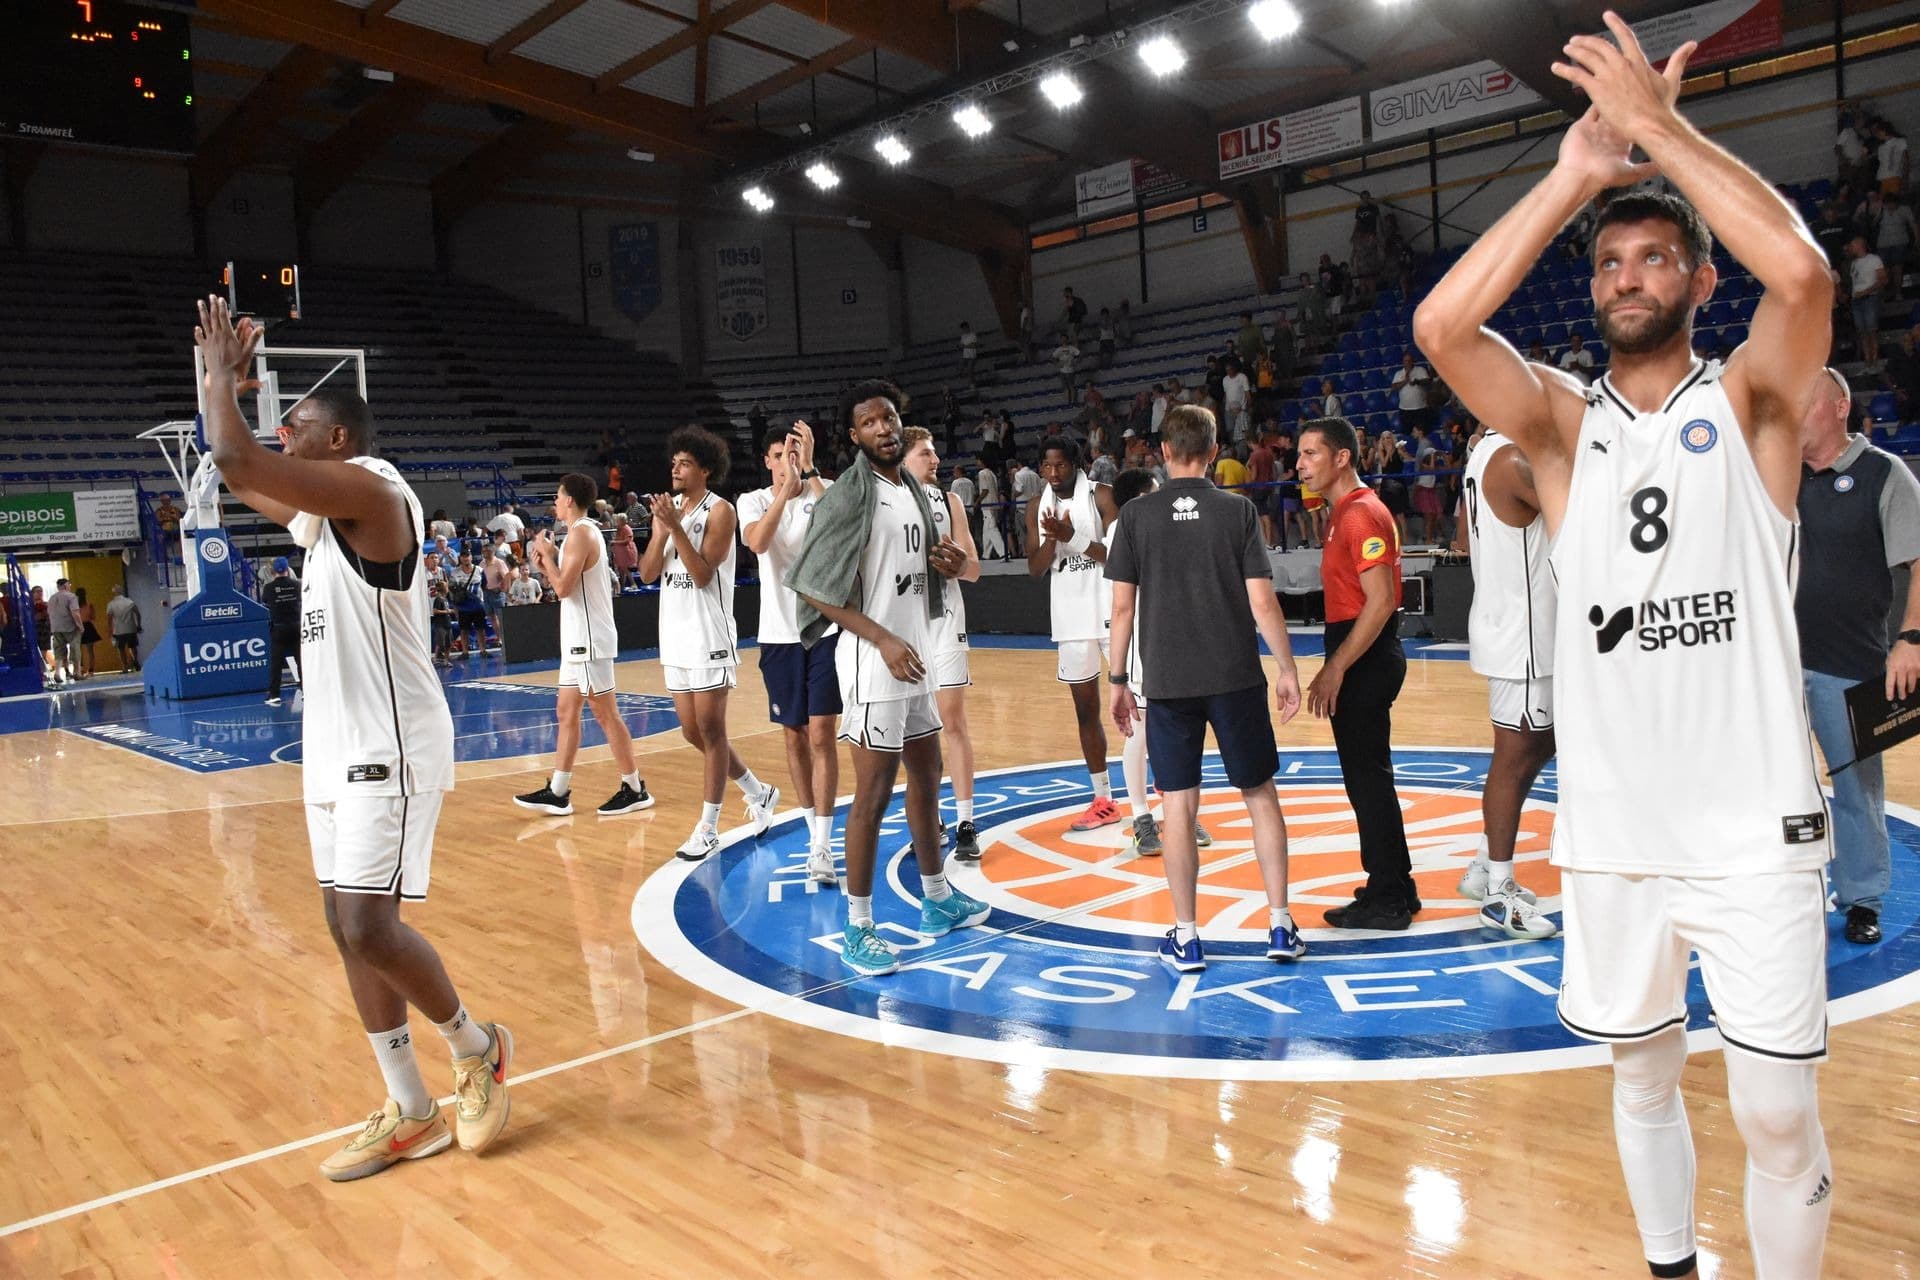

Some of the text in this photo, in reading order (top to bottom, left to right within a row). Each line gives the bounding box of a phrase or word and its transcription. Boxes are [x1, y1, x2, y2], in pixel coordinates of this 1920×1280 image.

[182, 50, 189, 60] 3
[185, 95, 192, 105] 2
[18, 122, 75, 139] STRAMATEL
[1244, 119, 1282, 157] LIS
[1195, 216, 1205, 231] E
[718, 246, 762, 267] 1959
[280, 267, 294, 286] 0
[1630, 486, 1668, 554] 8
[903, 523, 920, 553] 10
[204, 606, 239, 618] Betclic
[1639, 590, 1735, 626] INTER
[1638, 617, 1736, 652] SPORT
[186, 659, 268, 675] LE DÉPARTEMENT
[389, 1033, 410, 1049] 23
